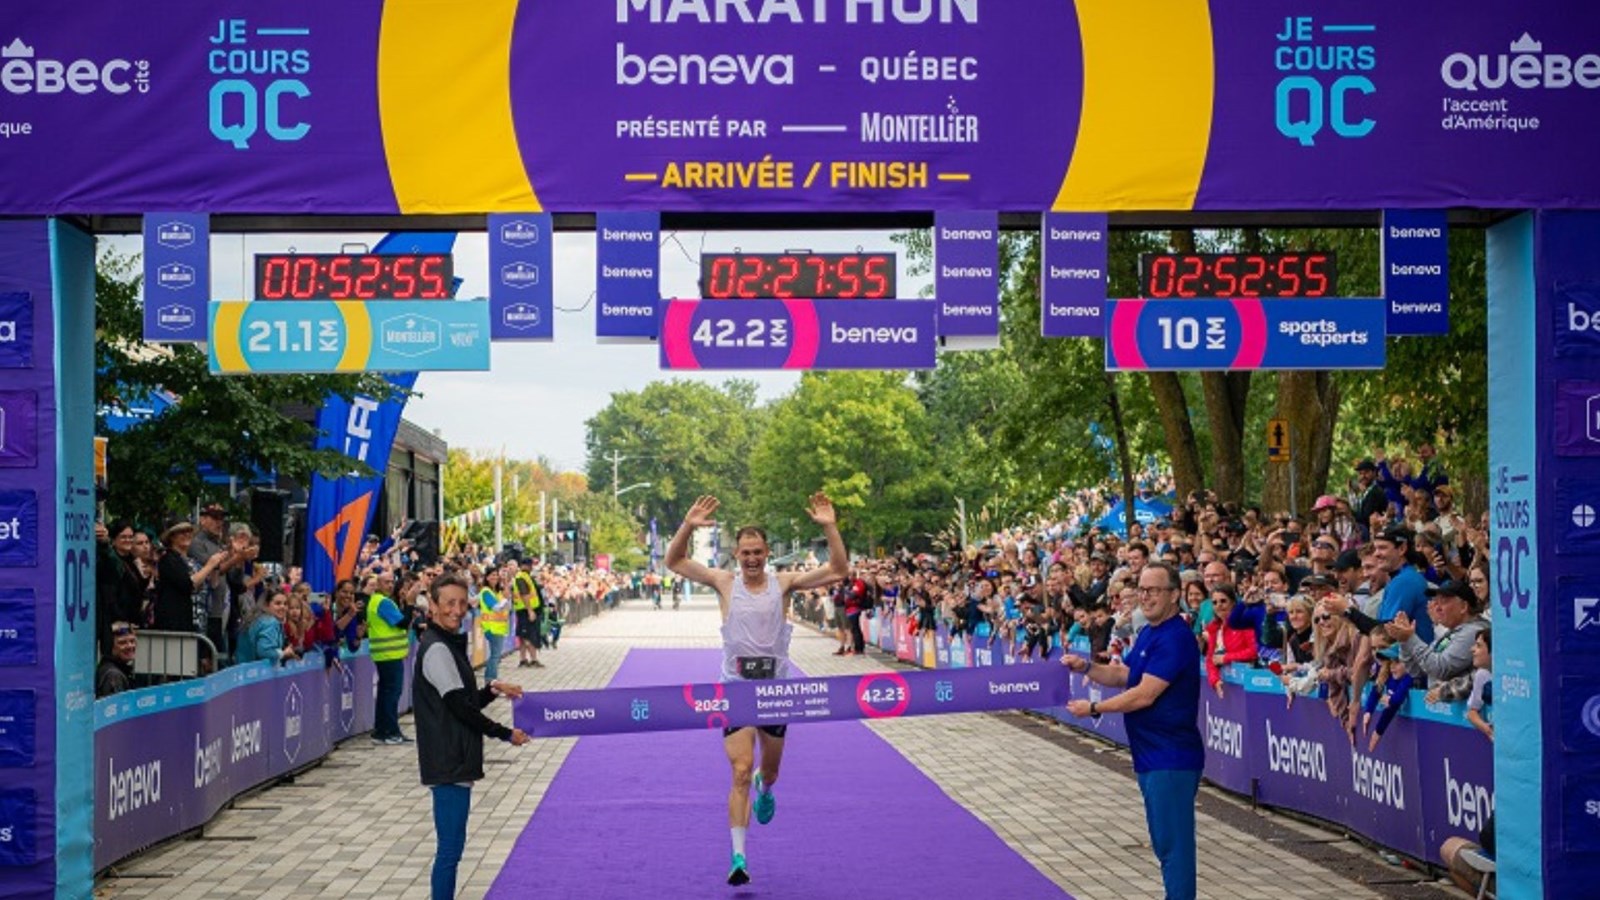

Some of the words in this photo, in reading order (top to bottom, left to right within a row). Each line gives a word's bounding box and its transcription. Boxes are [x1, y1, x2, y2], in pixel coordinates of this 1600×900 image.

[209, 20, 247, 43] JE
[1276, 17, 1313, 41] JE
[209, 50, 310, 74] COURS
[616, 43, 794, 85] beneva
[860, 51, 979, 83] QUÉBEC
[1275, 46, 1376, 71] COURS
[208, 79, 312, 149] QC
[1275, 75, 1377, 146] QC
[1443, 98, 1508, 112] l'accent
[616, 115, 720, 138] PRÉSENTÉ
[727, 121, 767, 137] PAR
[1441, 115, 1540, 132] d'Amérique
[662, 155, 793, 188] ARRIVÉE
[830, 162, 928, 188] FINISH
[603, 227, 653, 242] beneva
[942, 226, 992, 241] beneva
[1051, 226, 1101, 243] beneva
[1390, 225, 1441, 241] beneva
[603, 265, 653, 280] beneva
[708, 256, 889, 299] 02:27:55
[942, 264, 992, 279] beneva
[1051, 264, 1101, 281] beneva
[1149, 256, 1328, 299] 02:52:55
[1391, 262, 1441, 278] beneva
[603, 303, 653, 318] beneva
[942, 302, 992, 318] beneva
[1050, 302, 1100, 319] beneva
[1391, 300, 1441, 316] beneva
[248, 321, 313, 352] 21.1
[319, 320, 338, 351] KM
[692, 319, 765, 348] 42.2
[769, 318, 787, 348] KM
[831, 323, 918, 344] beneva
[1158, 317, 1199, 350] 10
[1206, 317, 1226, 349] KM
[1279, 319, 1337, 337] sports
[1300, 330, 1368, 347] experts
[1497, 535, 1531, 618] QC
[64, 549, 90, 632] QC
[755, 682, 829, 697] MARATHON
[988, 681, 1040, 694] beneva
[544, 707, 596, 721] beneva
[694, 699, 730, 712] 2023
[1205, 702, 1243, 758] beneva
[1265, 719, 1328, 782] beneva
[108, 757, 161, 820] beneva
[1443, 757, 1495, 832] ben
